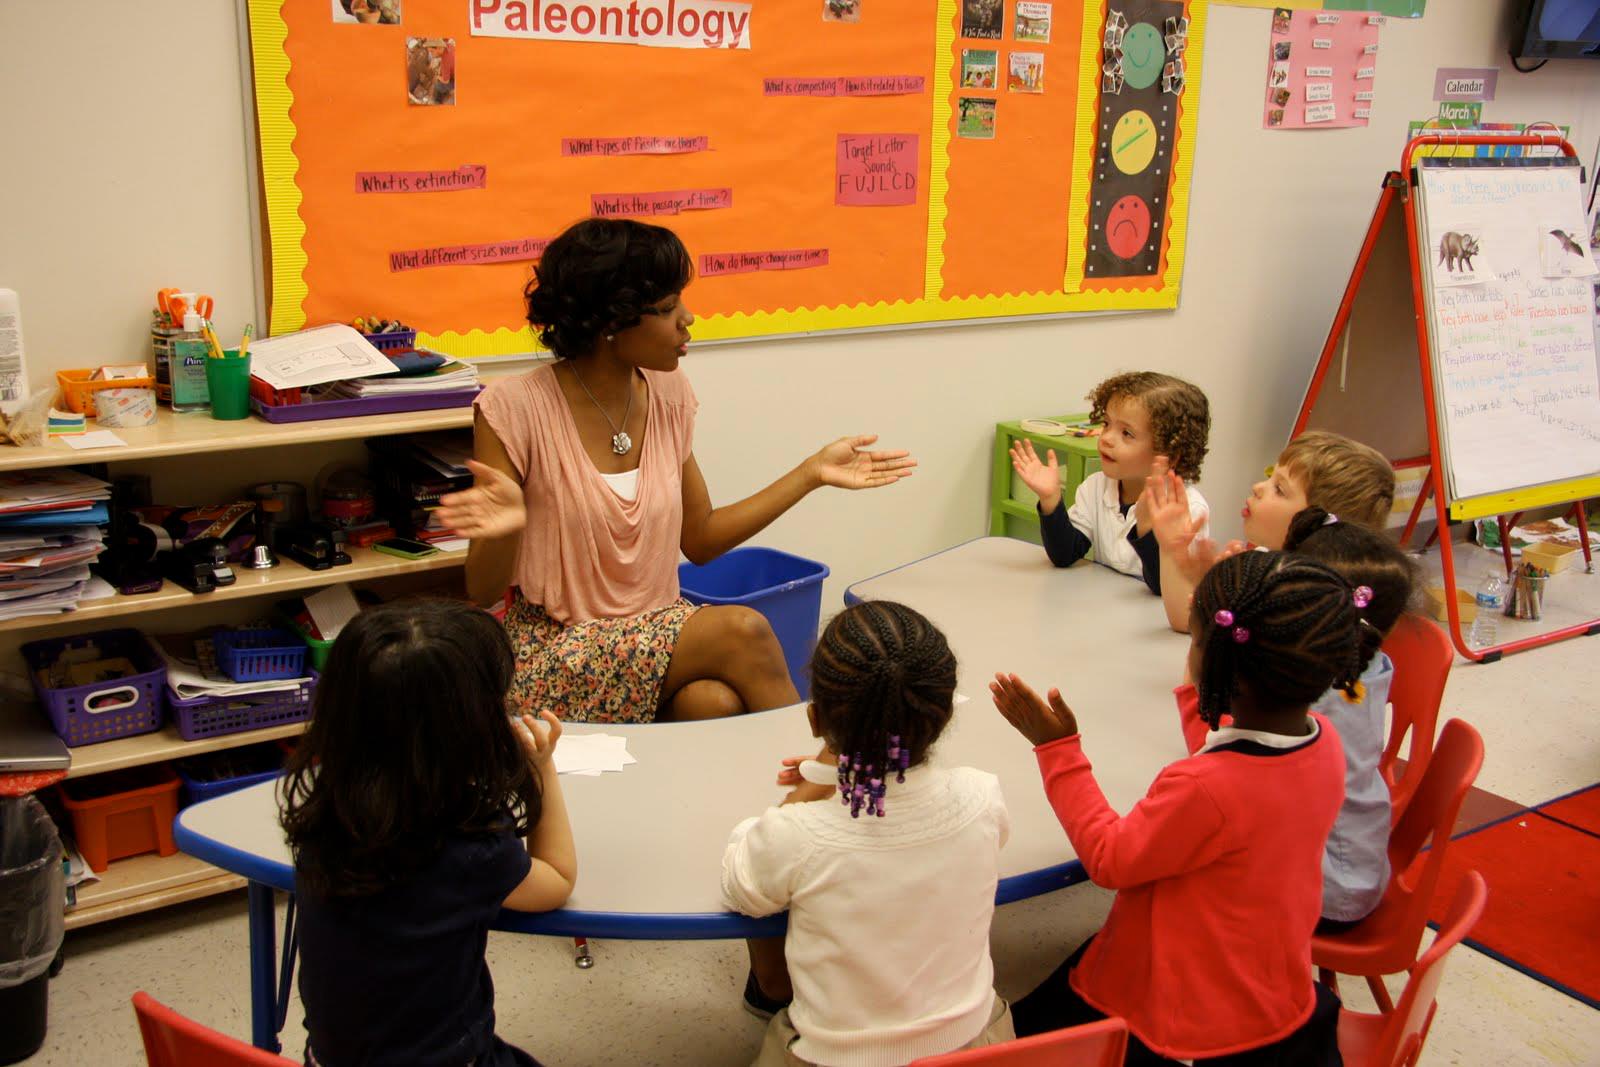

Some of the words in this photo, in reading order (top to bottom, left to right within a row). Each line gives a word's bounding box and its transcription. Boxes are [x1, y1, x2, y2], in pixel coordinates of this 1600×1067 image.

[473, 0, 749, 48] Paleontology
[1446, 80, 1484, 93] Calendar
[1440, 103, 1470, 120] March
[569, 140, 593, 155] What
[622, 137, 632, 151] of
[841, 139, 874, 163] Target
[878, 137, 908, 154] Letter
[361, 175, 395, 193] What
[397, 176, 410, 191] is
[415, 165, 486, 190] extinction?
[594, 200, 621, 216] What
[621, 202, 631, 213] is
[632, 199, 650, 213] the
[652, 198, 685, 216] passage
[391, 253, 419, 271] What
[421, 248, 467, 265] different
[704, 255, 726, 273] How
[727, 254, 739, 270] do
